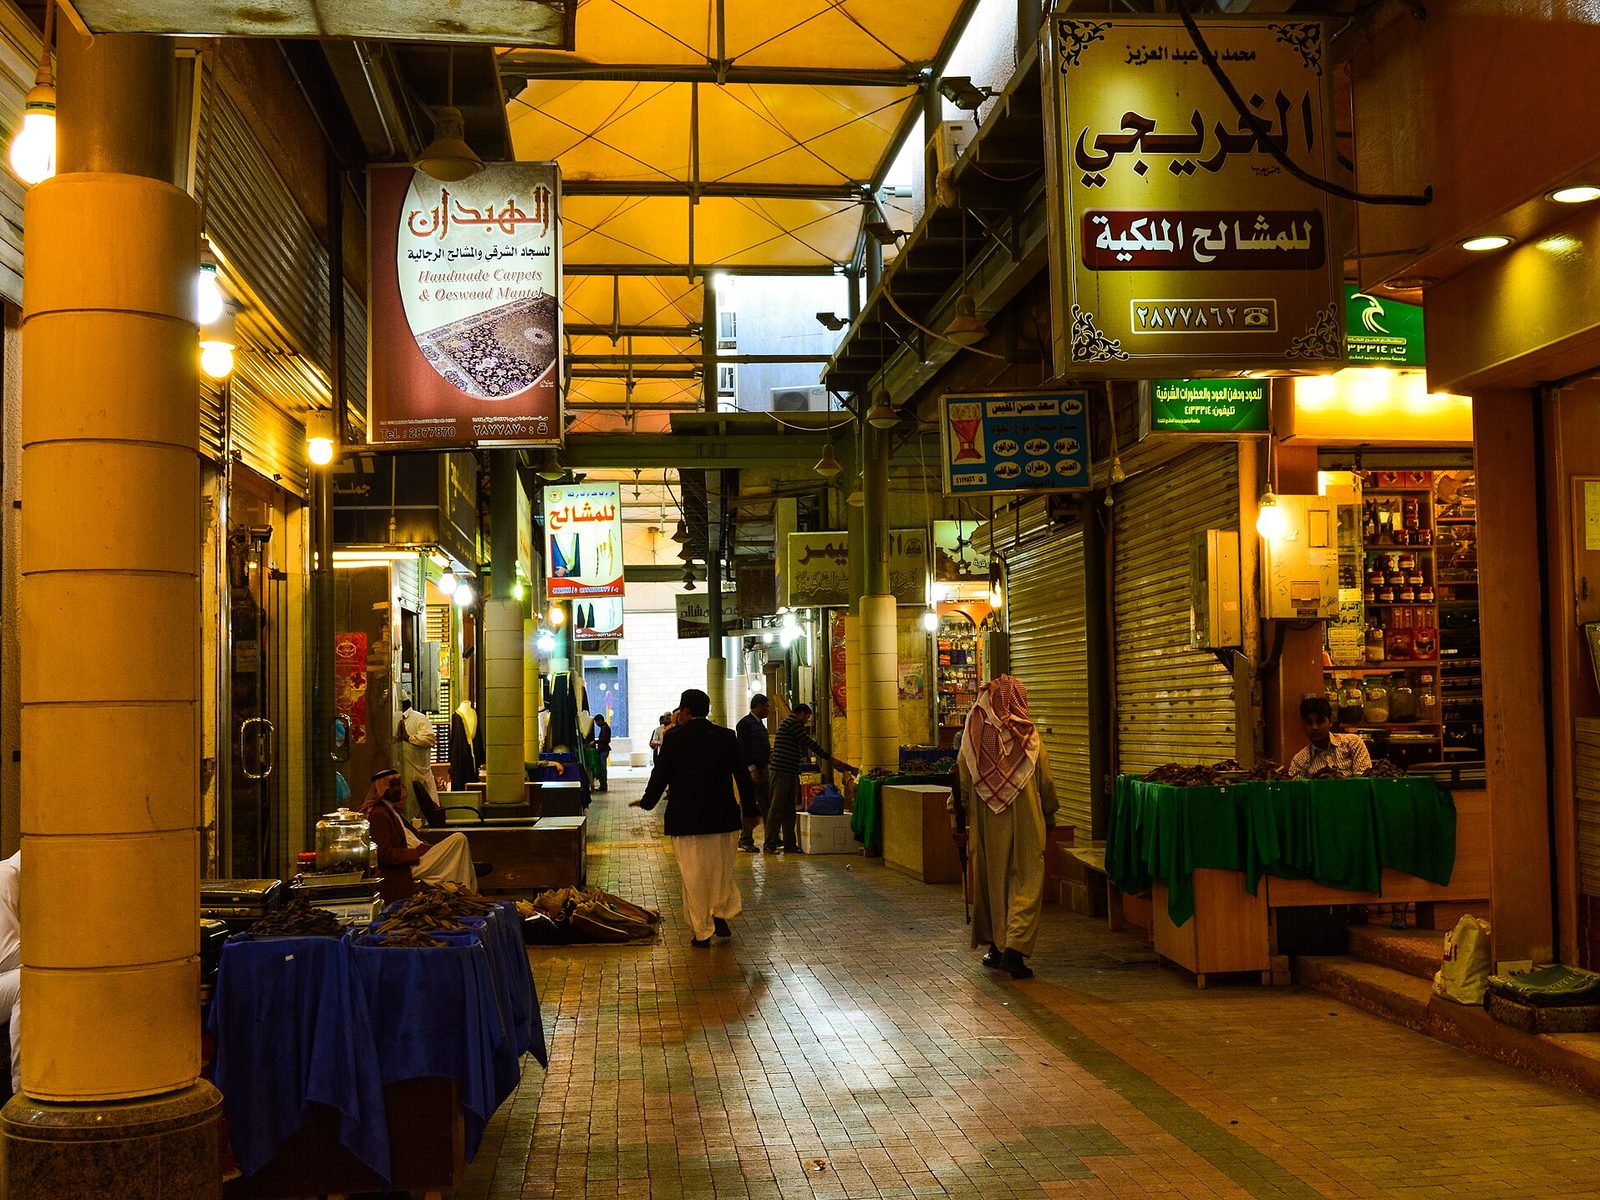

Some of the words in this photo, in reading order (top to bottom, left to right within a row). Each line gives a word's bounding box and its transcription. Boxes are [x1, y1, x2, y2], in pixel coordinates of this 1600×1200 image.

[1125, 45, 1168, 65] العزيز
[1172, 47, 1198, 65] عبد
[1222, 47, 1257, 62] محمد
[408, 186, 551, 239] الهبدان
[1091, 215, 1184, 262] الملكية
[1191, 214, 1312, 263] للمشالح
[407, 248, 445, 263] الرجالية
[447, 246, 483, 261] والمشالح
[485, 245, 517, 262] الشرقي
[520, 246, 551, 260] للسجاد
[418, 269, 490, 284] Handmade
[493, 268, 543, 284] Carpets
[418, 288, 430, 301] &
[1136, 306, 1238, 328] ٢٨٧٧٨٦٢
[472, 424, 527, 436] ٢٨٧٧٨٧٠
[549, 501, 616, 530] للمشالح
